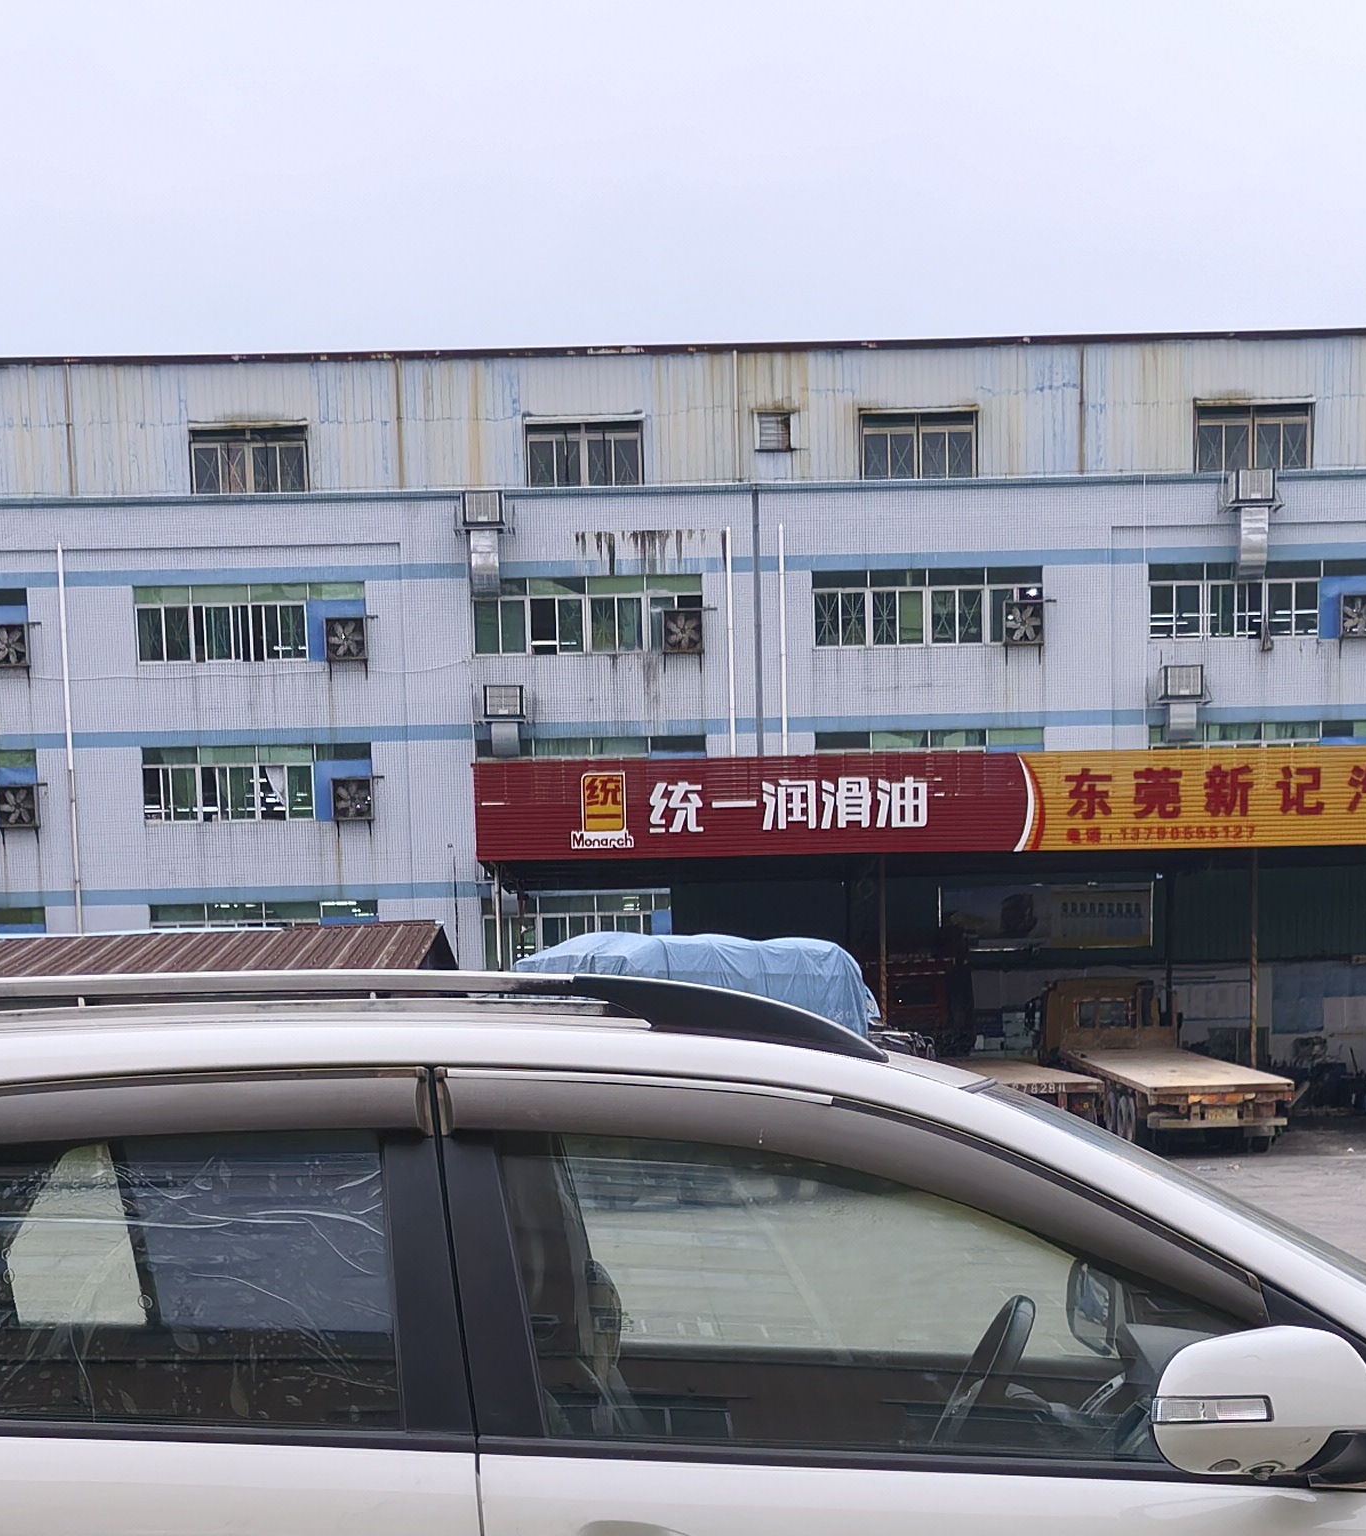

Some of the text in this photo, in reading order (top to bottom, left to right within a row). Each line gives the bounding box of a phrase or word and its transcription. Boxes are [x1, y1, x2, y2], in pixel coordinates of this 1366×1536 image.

[648, 776, 928, 834] 统一润滑油
[572, 831, 633, 848] Monarch
